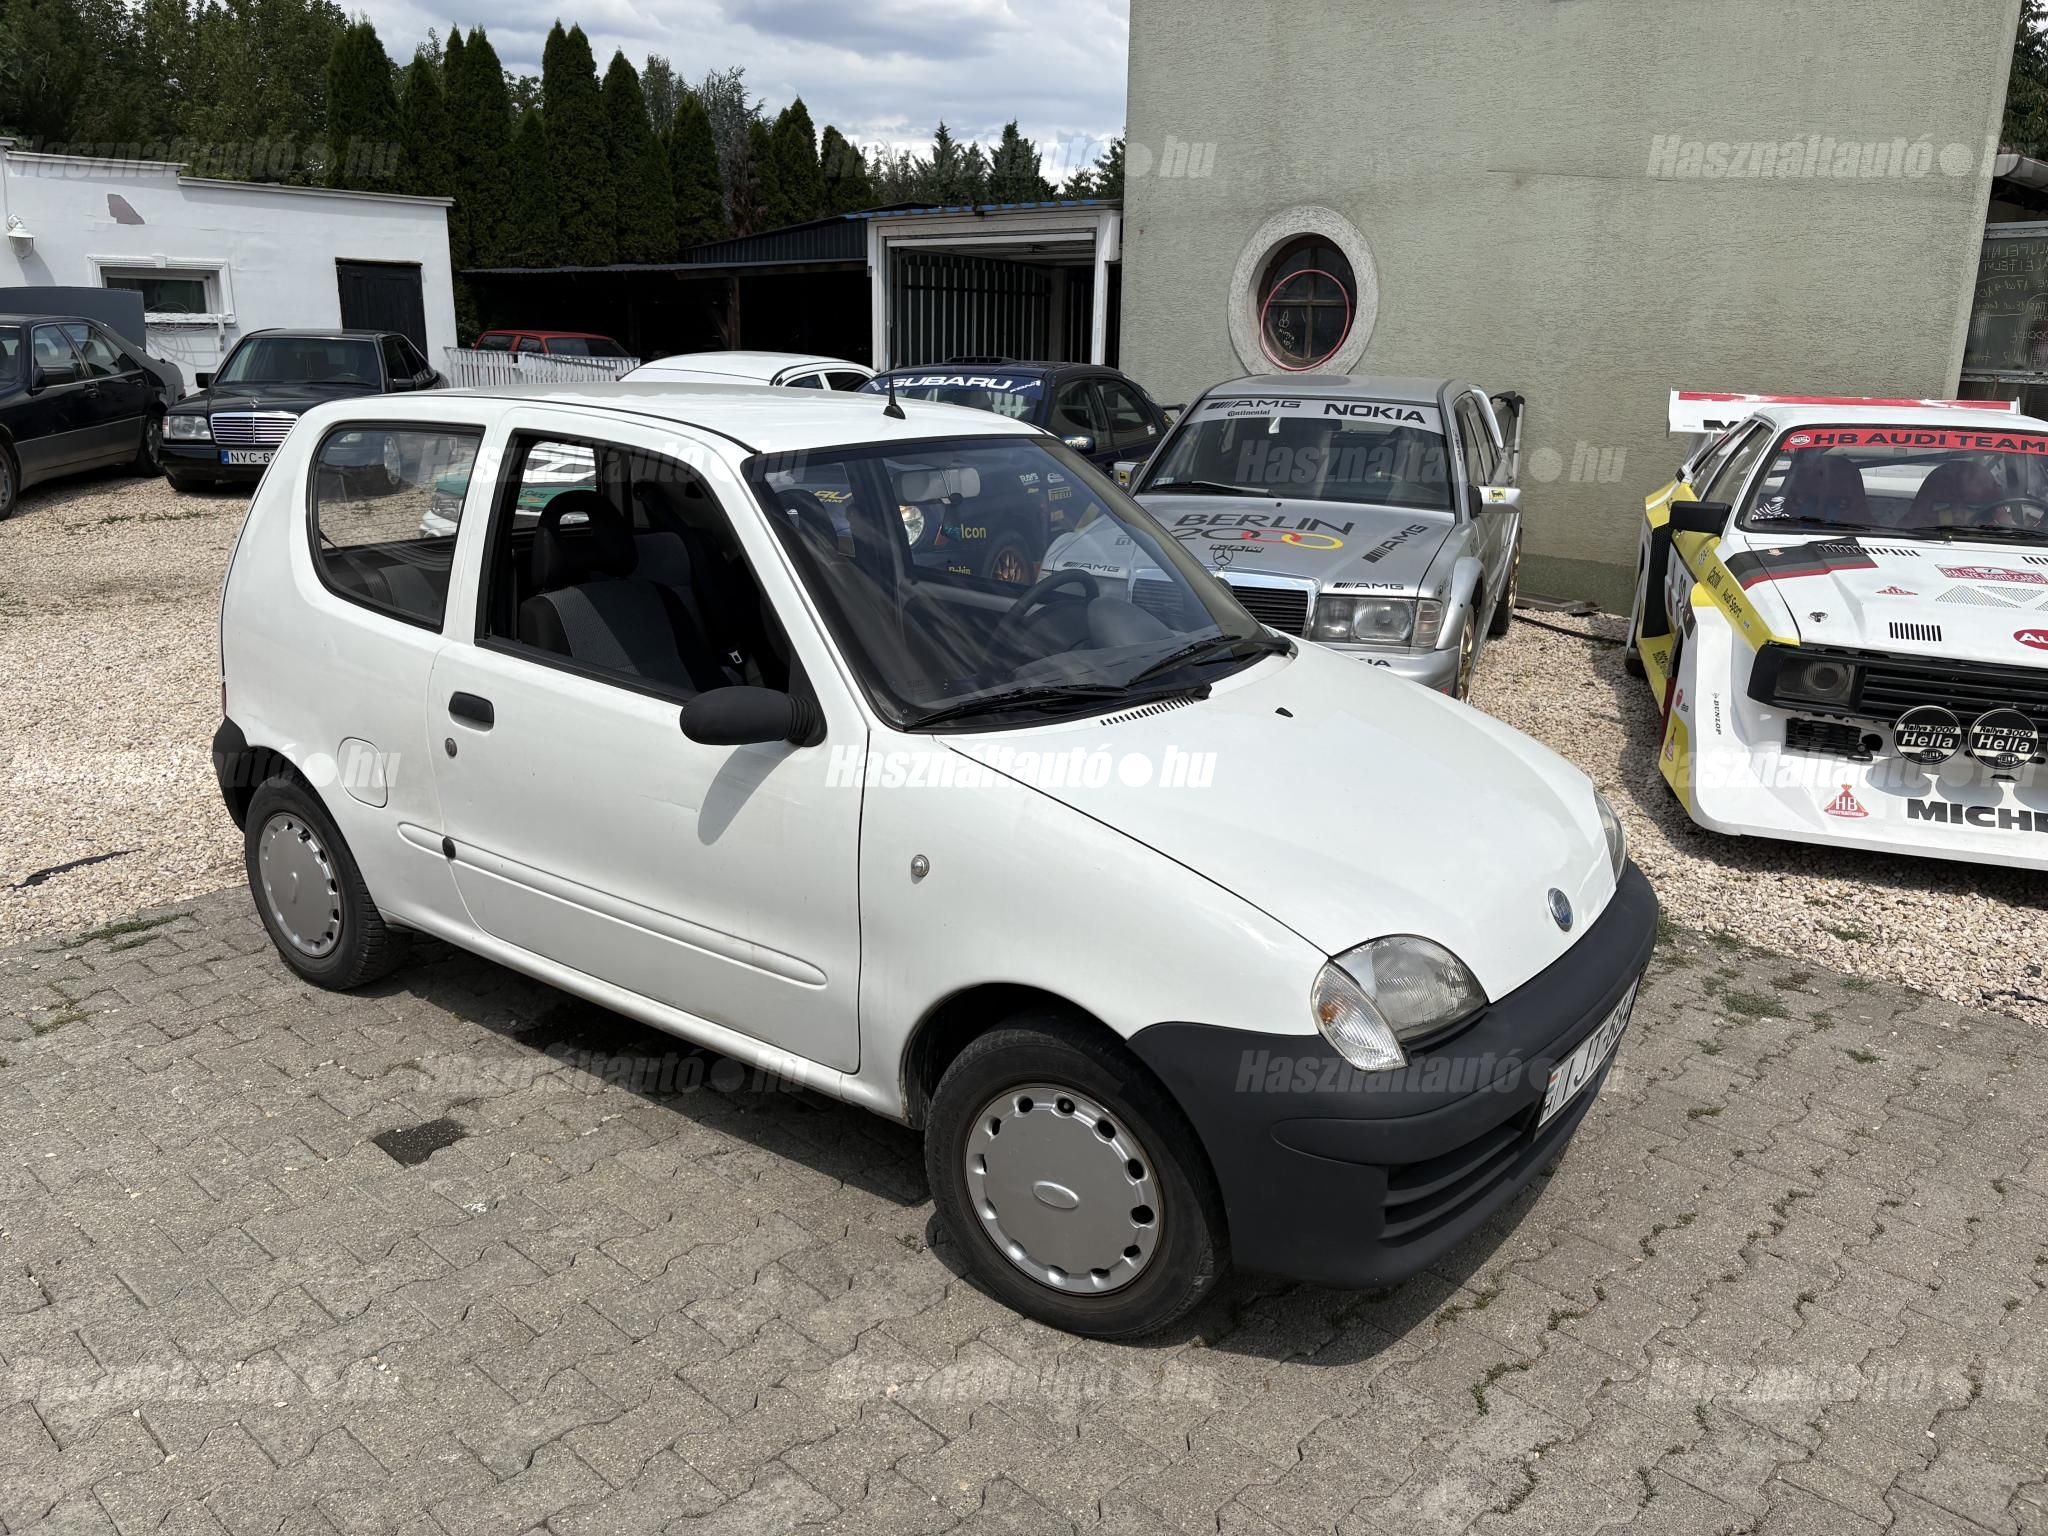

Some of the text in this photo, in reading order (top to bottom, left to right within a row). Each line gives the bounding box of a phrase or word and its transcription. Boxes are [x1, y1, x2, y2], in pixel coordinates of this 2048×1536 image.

[885, 376, 1012, 389] SUBARU
[1232, 400, 1426, 424] AMG NOKIA
[1813, 433, 1858, 445] HB
[1865, 433, 1946, 446] AUDI
[1955, 435, 2046, 453] TEAM
[1174, 514, 1355, 536] BERLIN
[1080, 563, 1120, 573] AMG
[1713, 699, 1722, 735] DUNLOP
[1928, 725, 1957, 734] 3000
[2005, 728, 2034, 738] 3000
[1901, 732, 1954, 748] Hella
[1977, 735, 2031, 753] Hella
[1835, 795, 1858, 811] HB
